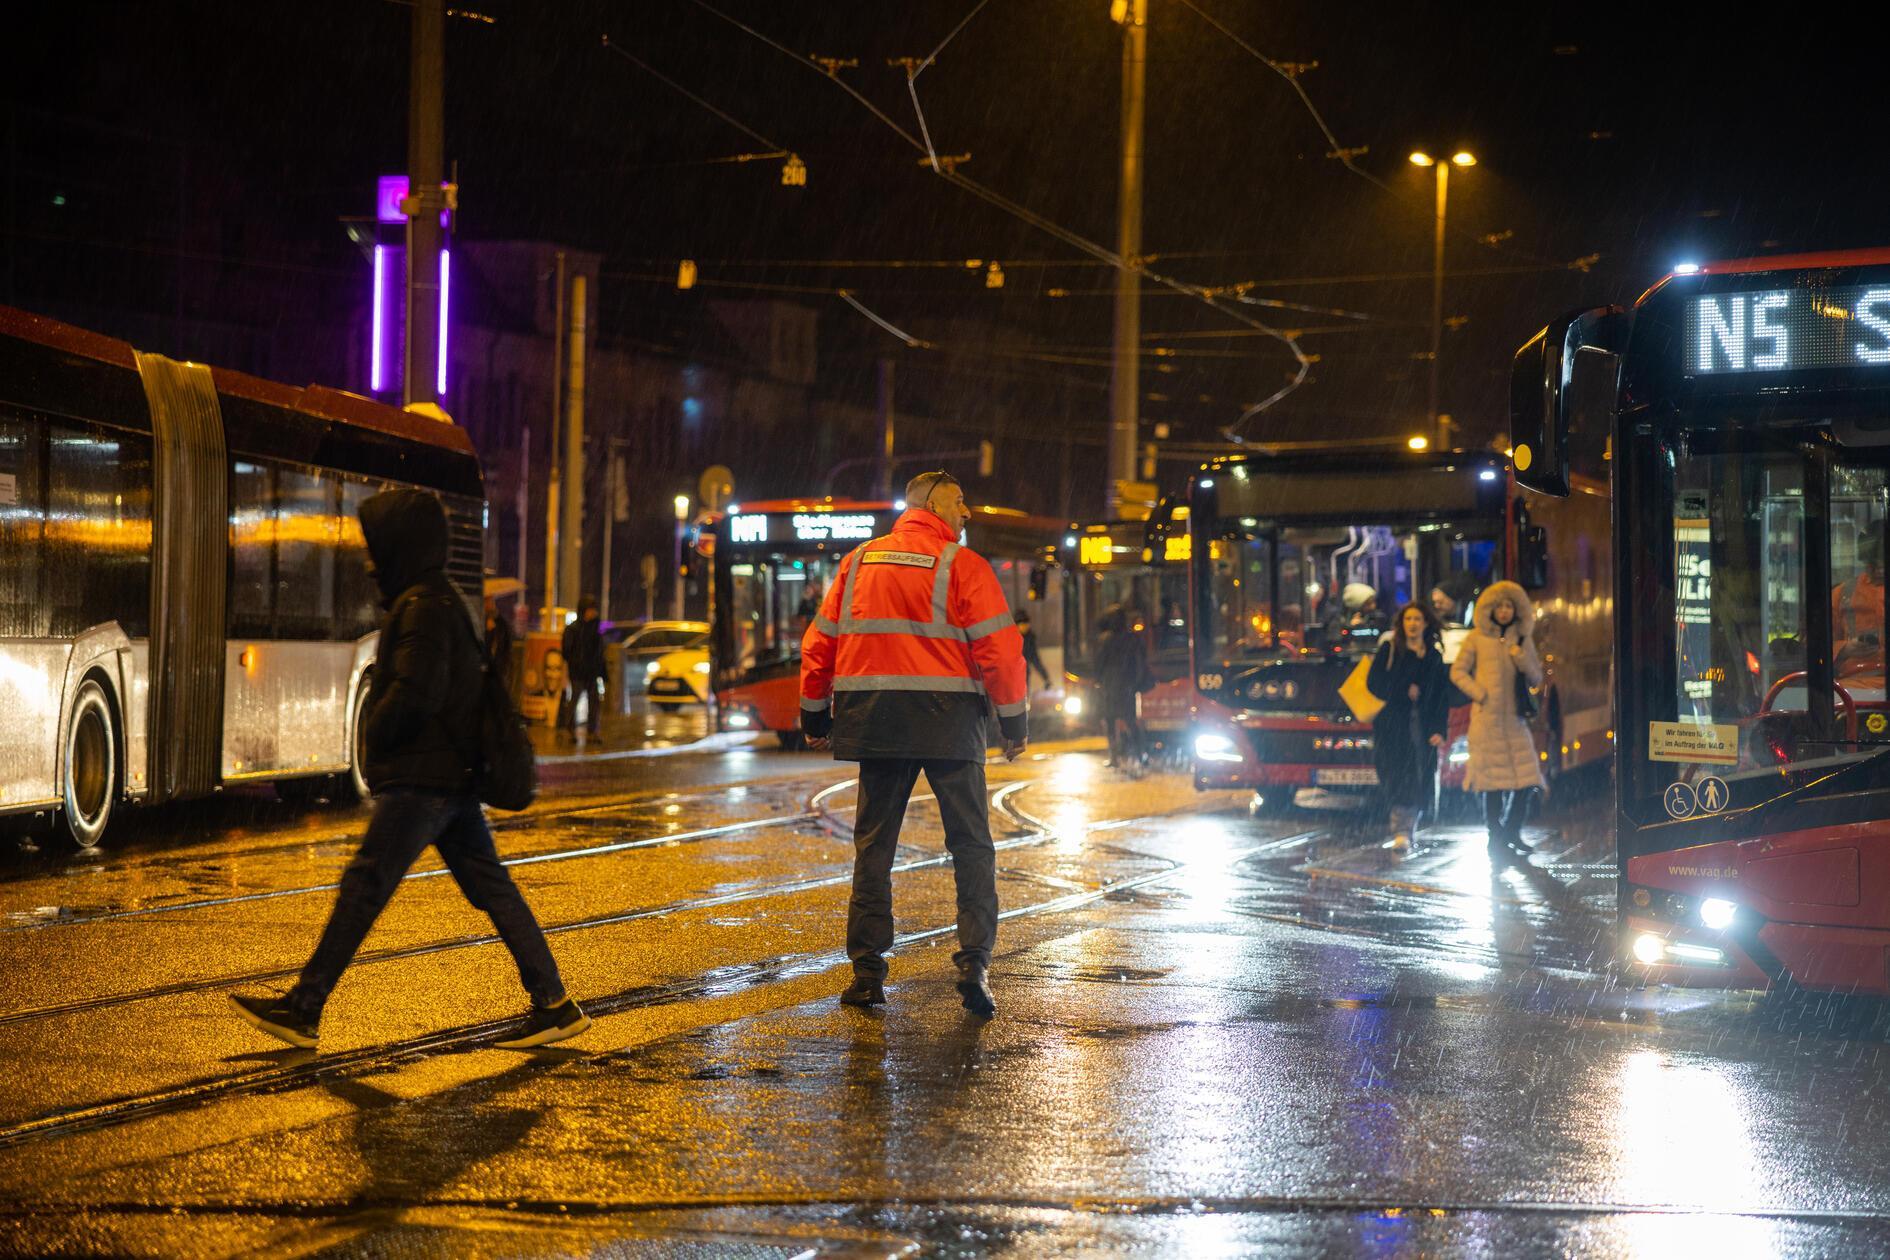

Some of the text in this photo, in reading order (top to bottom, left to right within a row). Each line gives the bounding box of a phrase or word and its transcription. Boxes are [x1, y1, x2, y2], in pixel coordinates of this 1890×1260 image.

[1699, 295, 1788, 368] N5
[1665, 728, 1676, 736] Wir
[1677, 729, 1696, 737] fahren
[1673, 740, 1696, 750] Auftrag
[1668, 865, 1738, 880] www.vag.de
